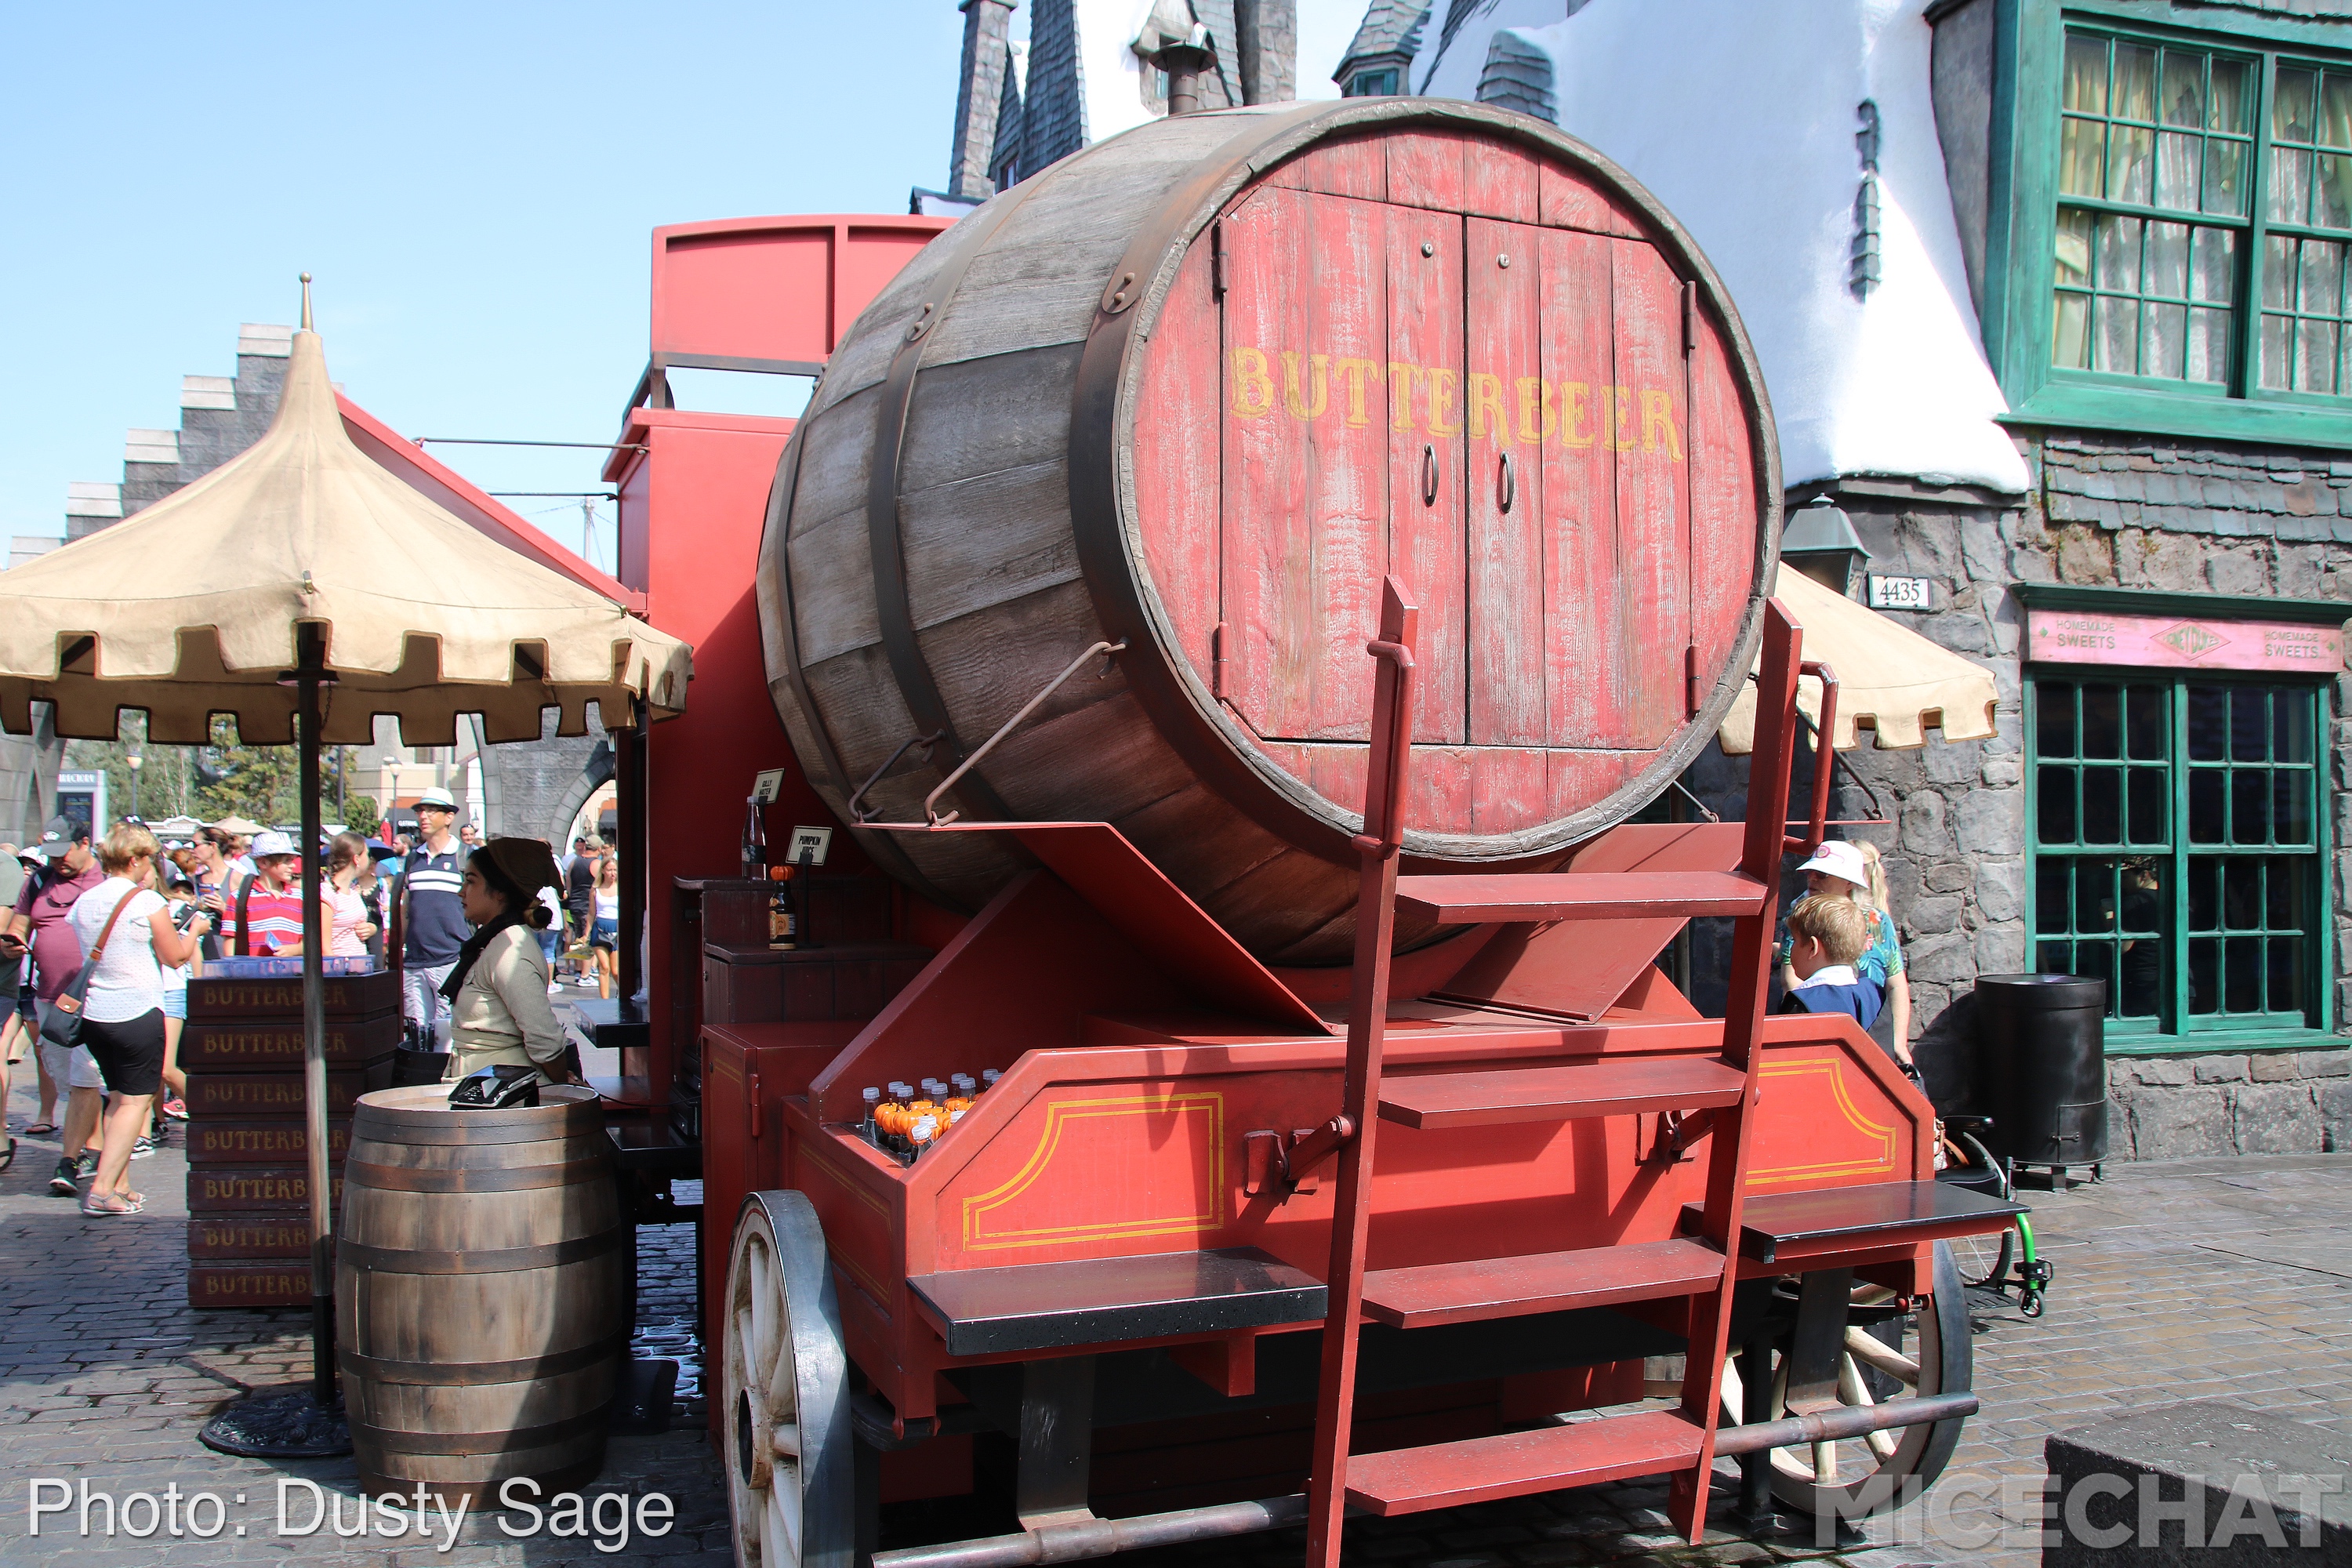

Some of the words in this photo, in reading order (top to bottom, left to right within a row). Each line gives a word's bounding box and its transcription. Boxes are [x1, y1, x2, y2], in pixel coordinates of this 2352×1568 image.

[1230, 347, 1684, 463] BUTTERBEER
[1879, 582, 1920, 601] 4435
[2056, 619, 2115, 633] HOMEMADE
[2057, 633, 2115, 649] SWEETS
[2264, 630, 2319, 642] HOMEMADE
[2265, 644, 2319, 659] SWEETS
[59, 773, 96, 782] IRECTORY
[798, 835, 821, 846] PUMPKIN
[204, 986, 347, 1006] BUTTERBER
[204, 1033, 347, 1053] BUTTERBER
[204, 1083, 347, 1104] BUTTERBR
[204, 1129, 347, 1150] BUTTERBR
[205, 1179, 344, 1200] BUTTERBR
